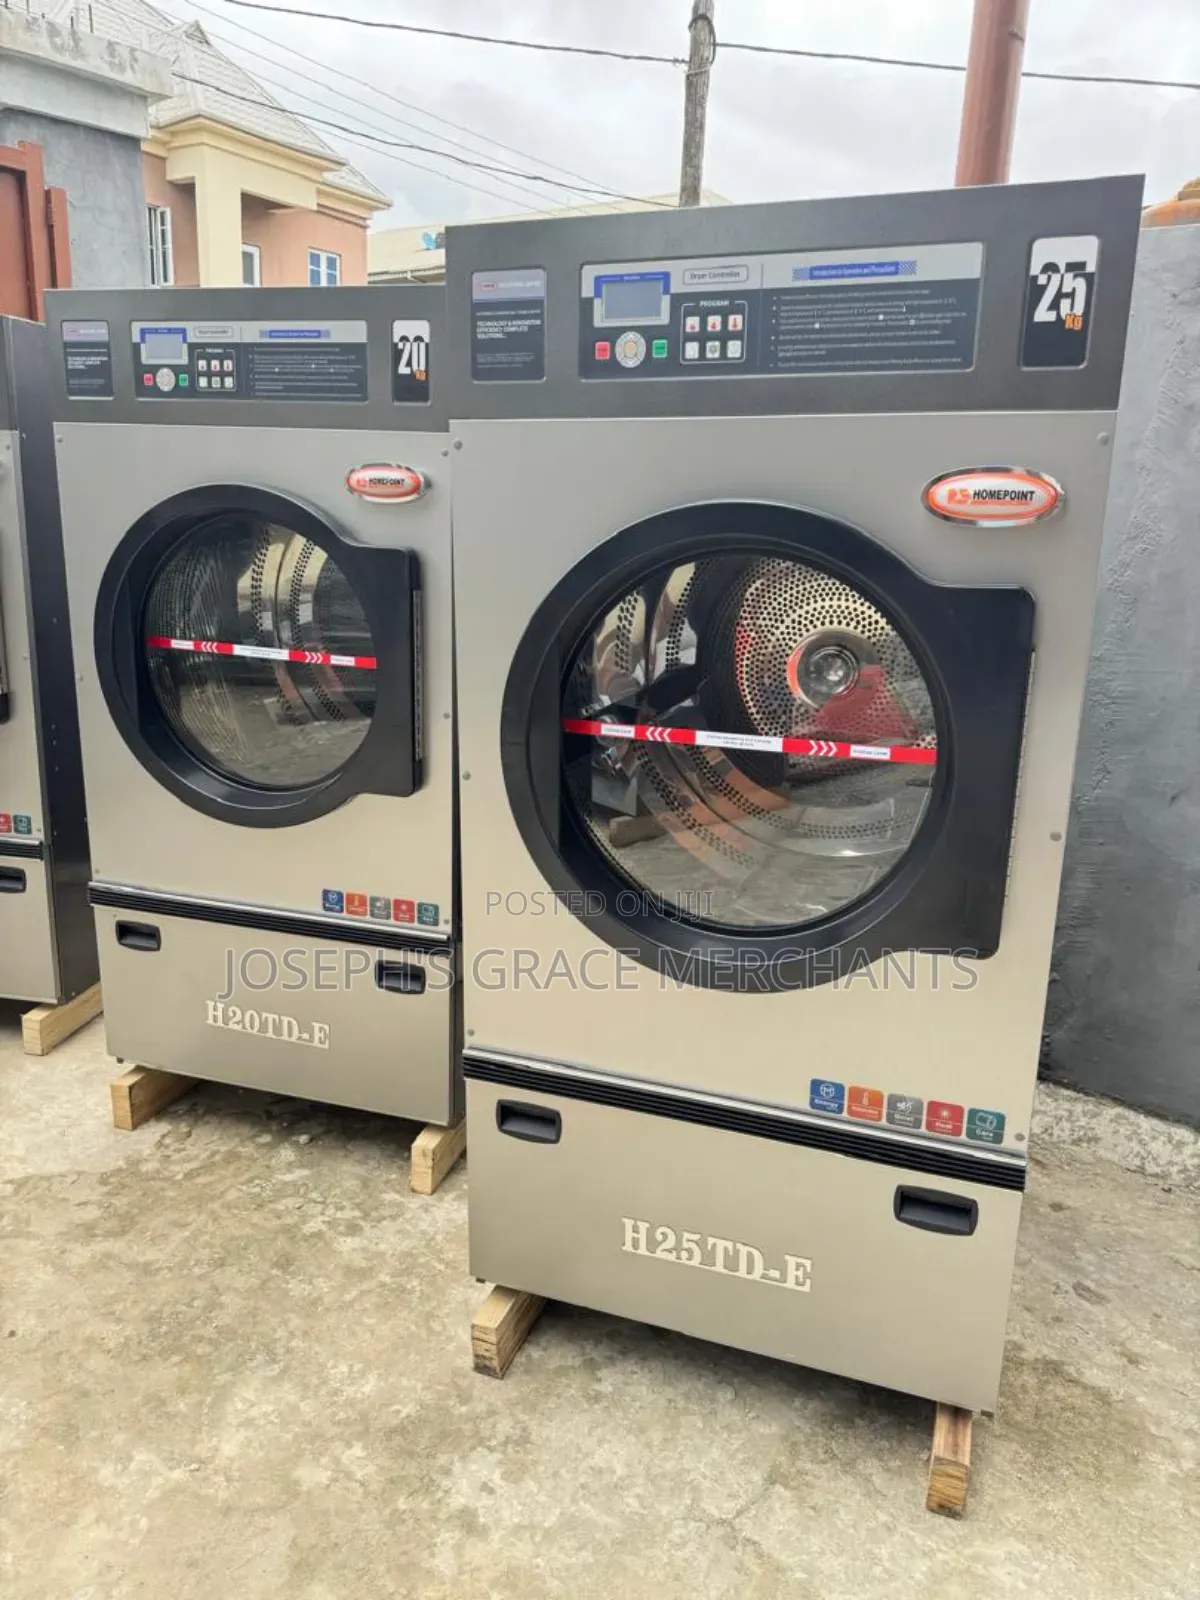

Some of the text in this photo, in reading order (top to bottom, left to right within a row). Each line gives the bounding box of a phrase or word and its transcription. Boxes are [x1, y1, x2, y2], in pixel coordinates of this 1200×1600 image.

[699, 299, 730, 307] PROGRAM
[1033, 260, 1087, 322] 25
[397, 334, 427, 375] 20
[972, 488, 1036, 502] HOMEPOINT
[204, 999, 331, 1050] H20TD-E
[620, 1216, 814, 1293] H25TD-E
